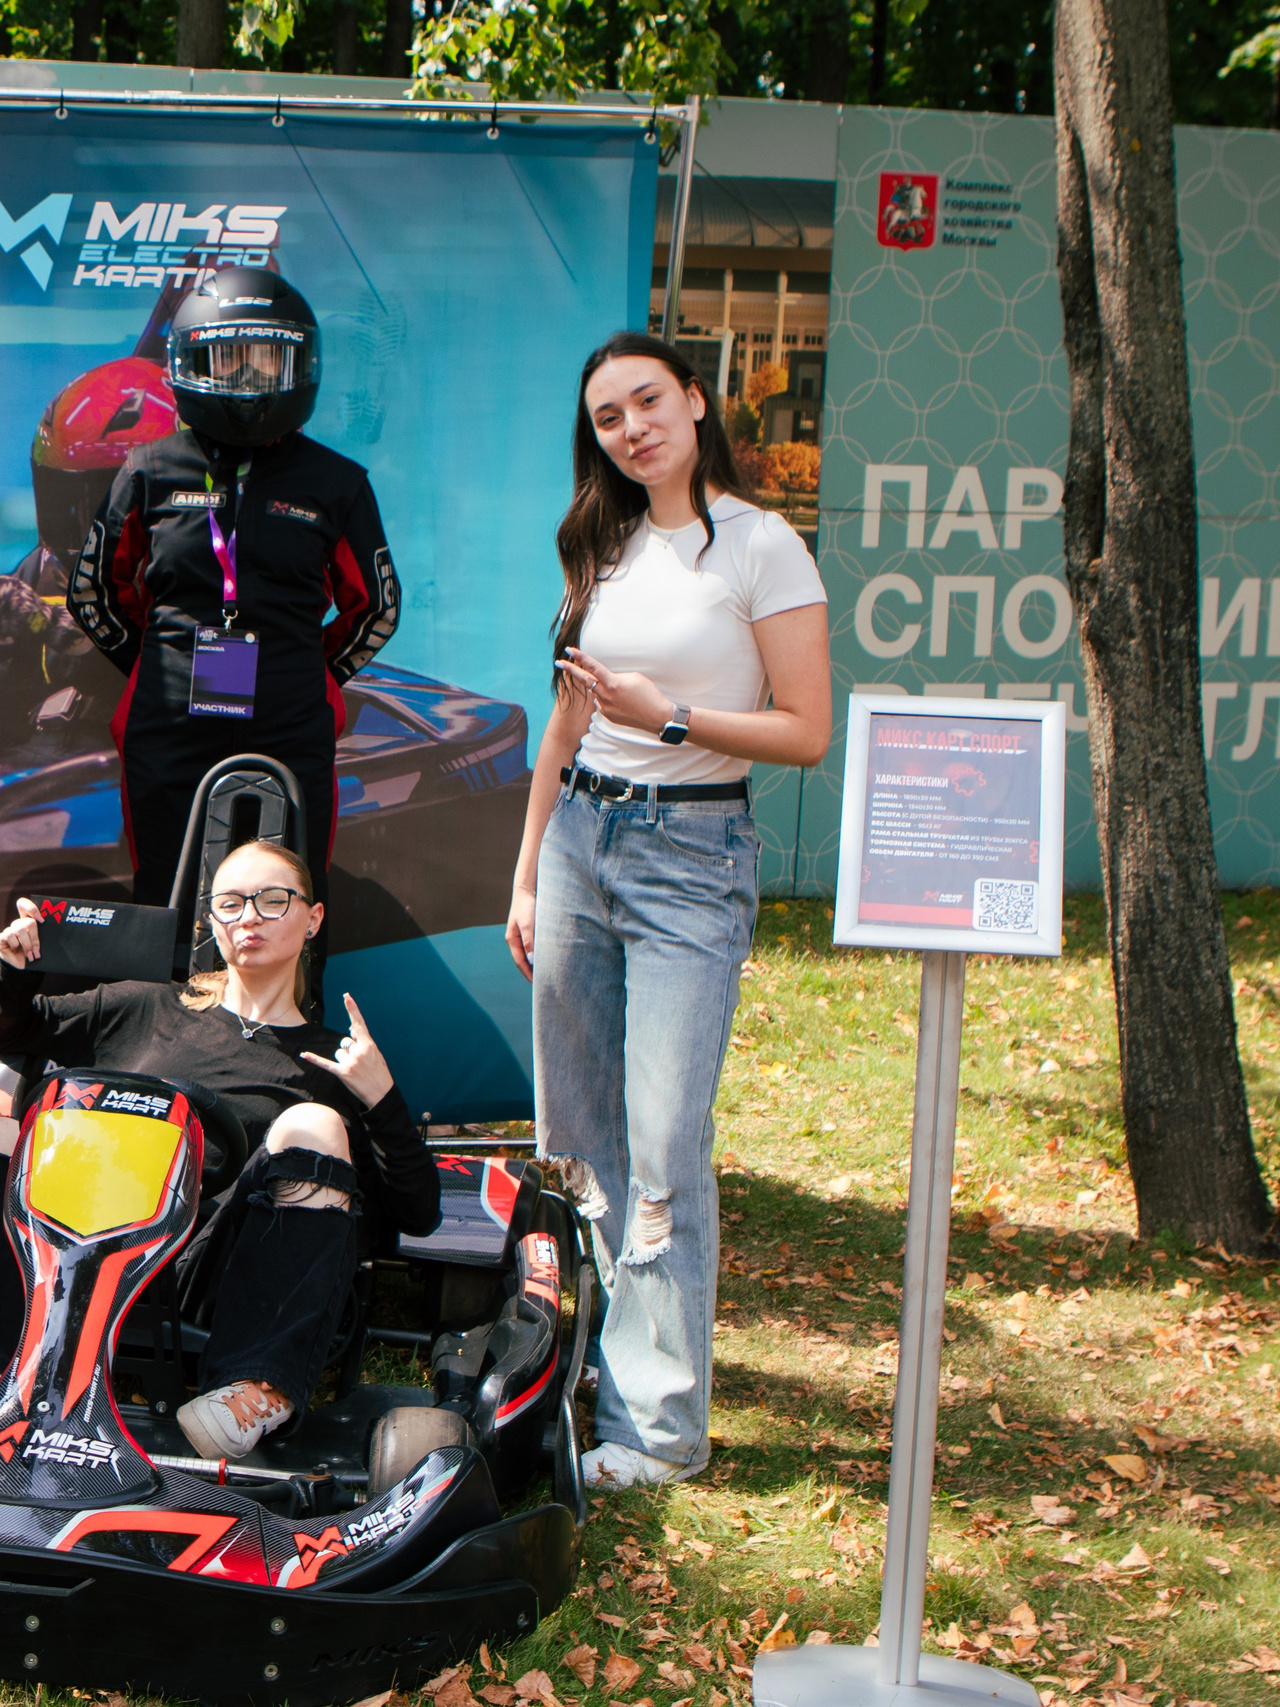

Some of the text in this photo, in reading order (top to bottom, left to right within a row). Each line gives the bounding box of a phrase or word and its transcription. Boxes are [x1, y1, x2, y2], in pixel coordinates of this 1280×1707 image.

[946, 178, 1013, 193] Комплекс
[944, 198, 1022, 213] городского
[85, 201, 288, 246] MIKS
[944, 216, 1012, 229] хозяйства
[942, 232, 997, 246] Москвы
[78, 243, 271, 266] ELECTRO
[199, 326, 305, 342] MIKS KARTING
[861, 464, 1067, 550] ПАР
[193, 703, 247, 715] УЧАСТНИК
[876, 727, 1021, 754] МИКС КАРТ СПОРТ
[875, 773, 949, 788] ХАРАКТЕРИСТИКИ
[909, 812, 932, 820] ДУГОЙ
[892, 831, 929, 839] СТАЛЬНАЯ
[930, 832, 970, 841] ТРУБЧАТАЯ
[870, 839, 1013, 853] ТОРМОЗНАЯ СИСТЕМА ГИДРАВЛИЧЕСКАЯ
[894, 849, 934, 858] ДВИГАТЕЛЯ
[68, 905, 116, 920] MIKS
[65, 916, 111, 926] KARTING
[106, 1089, 171, 1110] MIKS
[100, 1099, 167, 1116] KART
[29, 1429, 116, 1457] MIKS
[22, 1445, 109, 1469] KART
[347, 1488, 416, 1535] MIKS
[352, 1499, 421, 1547] KART
